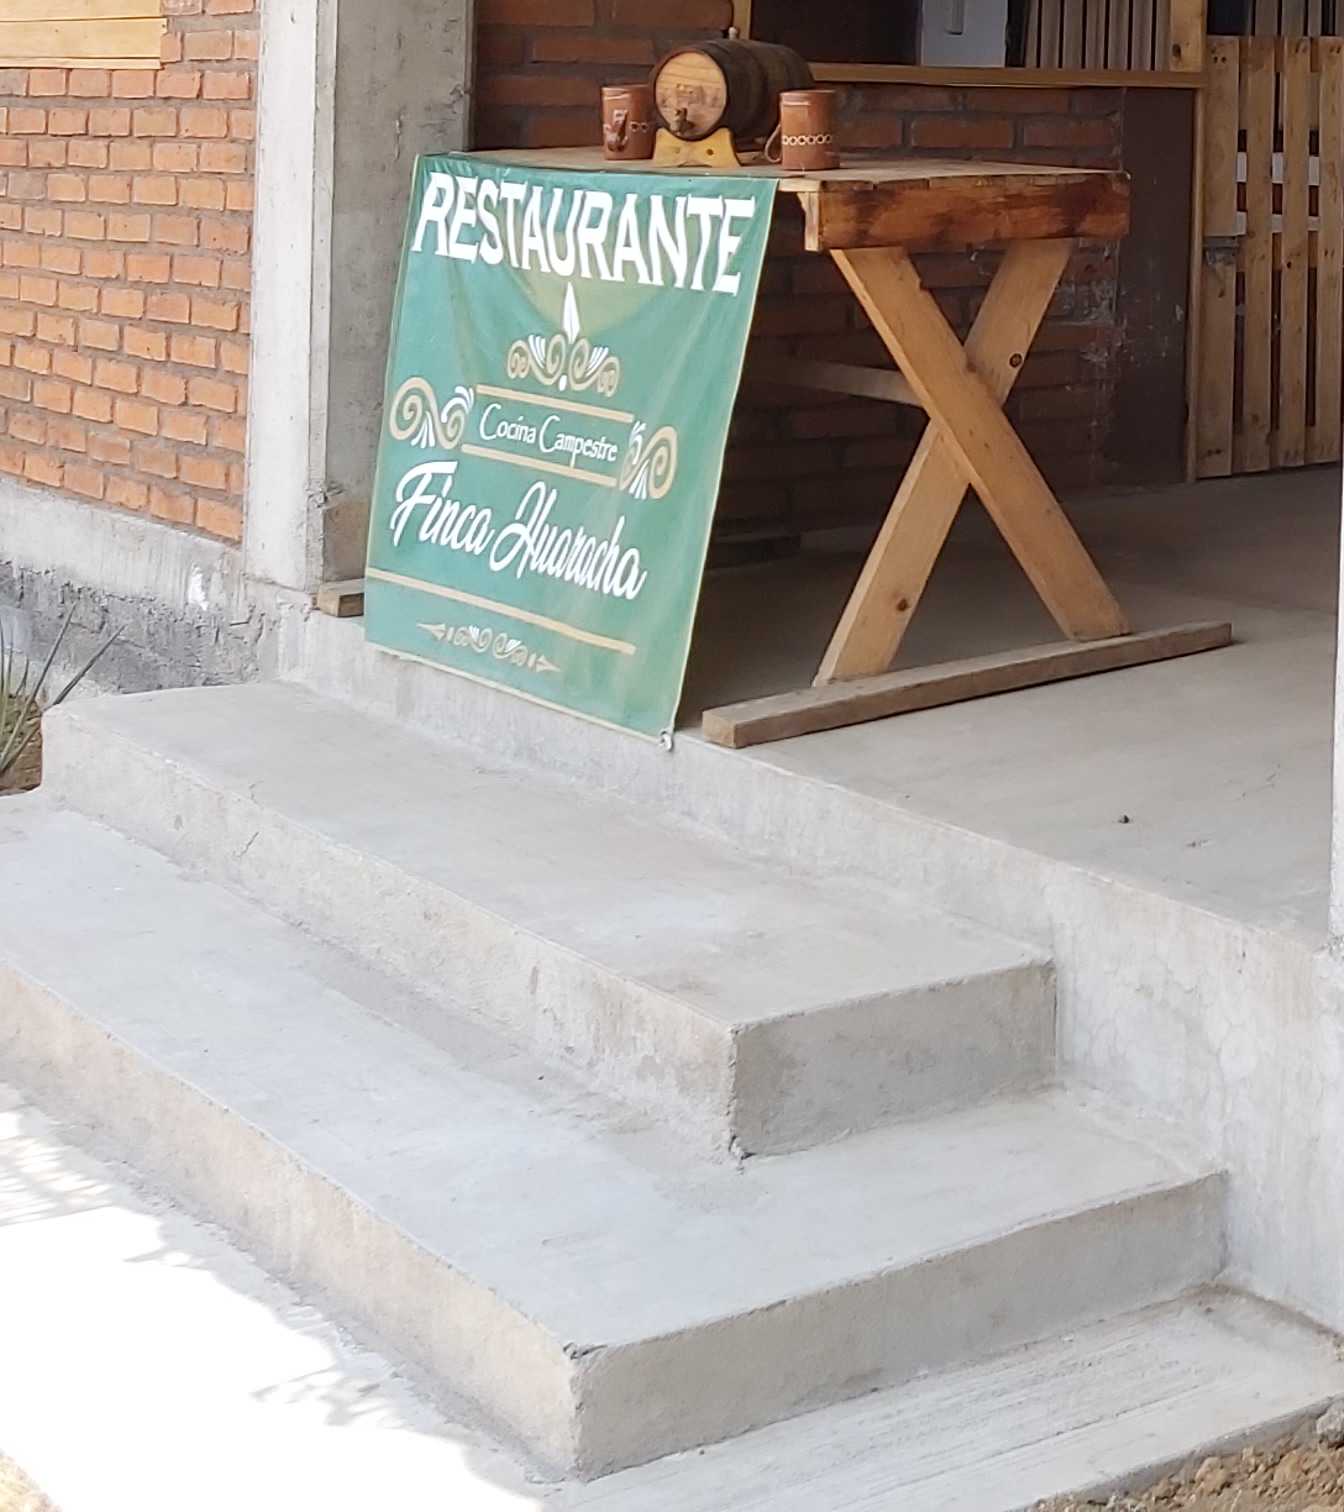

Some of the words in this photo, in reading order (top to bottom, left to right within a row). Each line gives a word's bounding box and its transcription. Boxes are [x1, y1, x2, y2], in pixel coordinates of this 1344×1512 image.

[410, 171, 757, 297] RESTAURANTE
[478, 402, 538, 444] Cocina
[538, 414, 620, 469] Campestre
[388, 460, 496, 557] Finca
[488, 481, 649, 601] Huaracha
